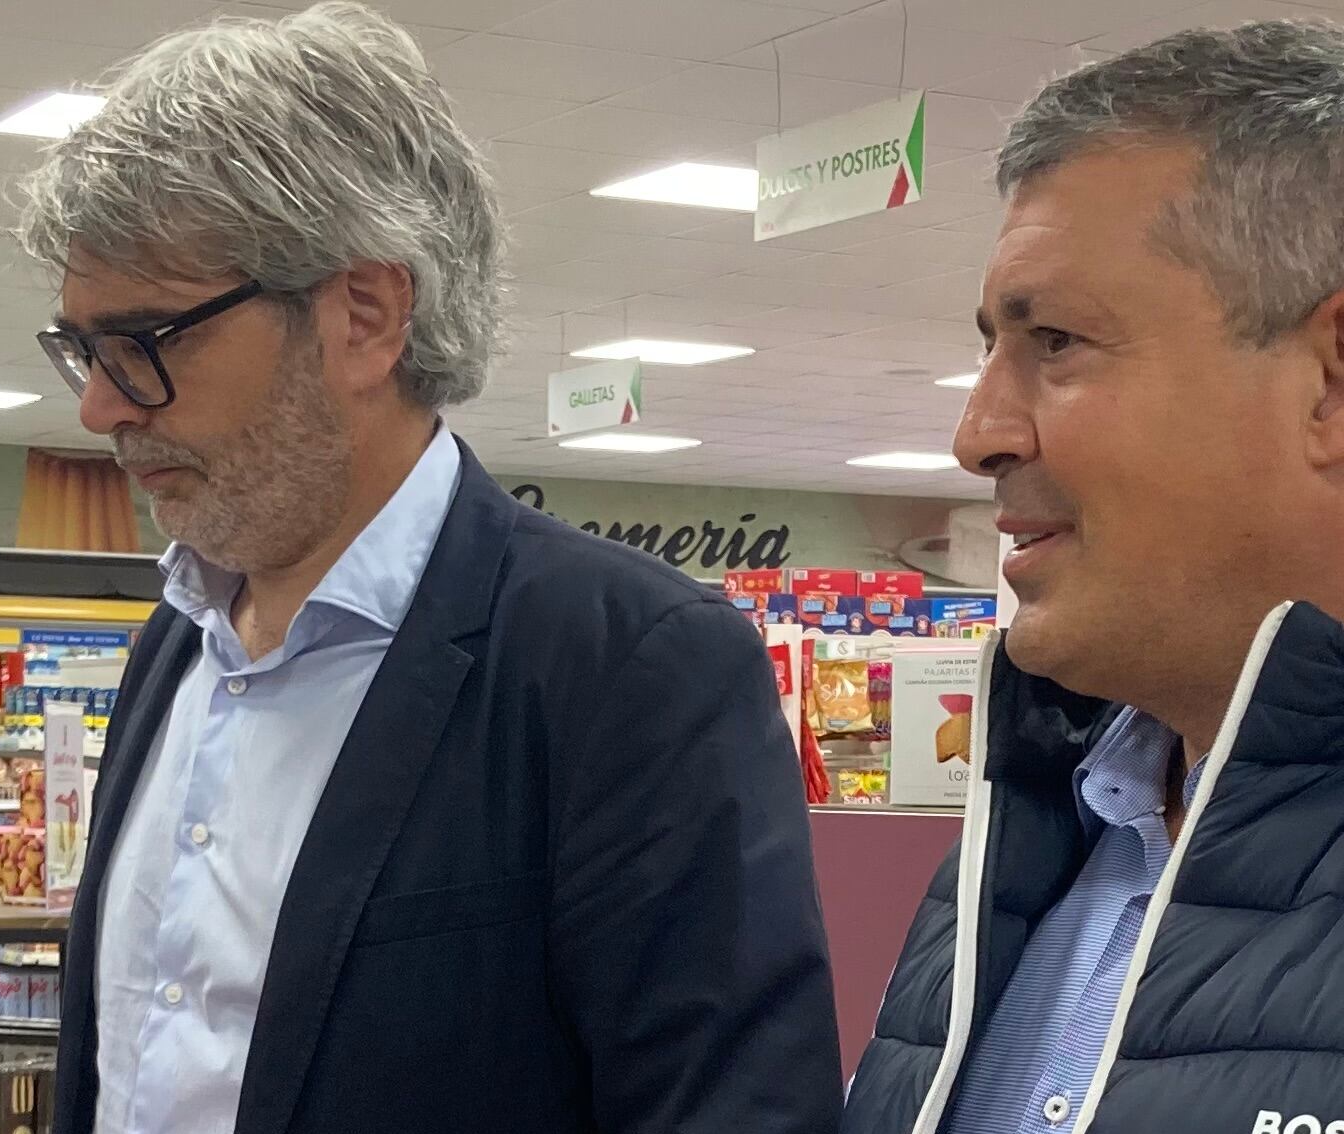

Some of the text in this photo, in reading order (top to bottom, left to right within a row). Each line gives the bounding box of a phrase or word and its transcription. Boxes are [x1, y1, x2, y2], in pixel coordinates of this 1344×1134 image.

[759, 138, 901, 201] DULCES Y POSTRES
[568, 383, 615, 409] GALLETAS
